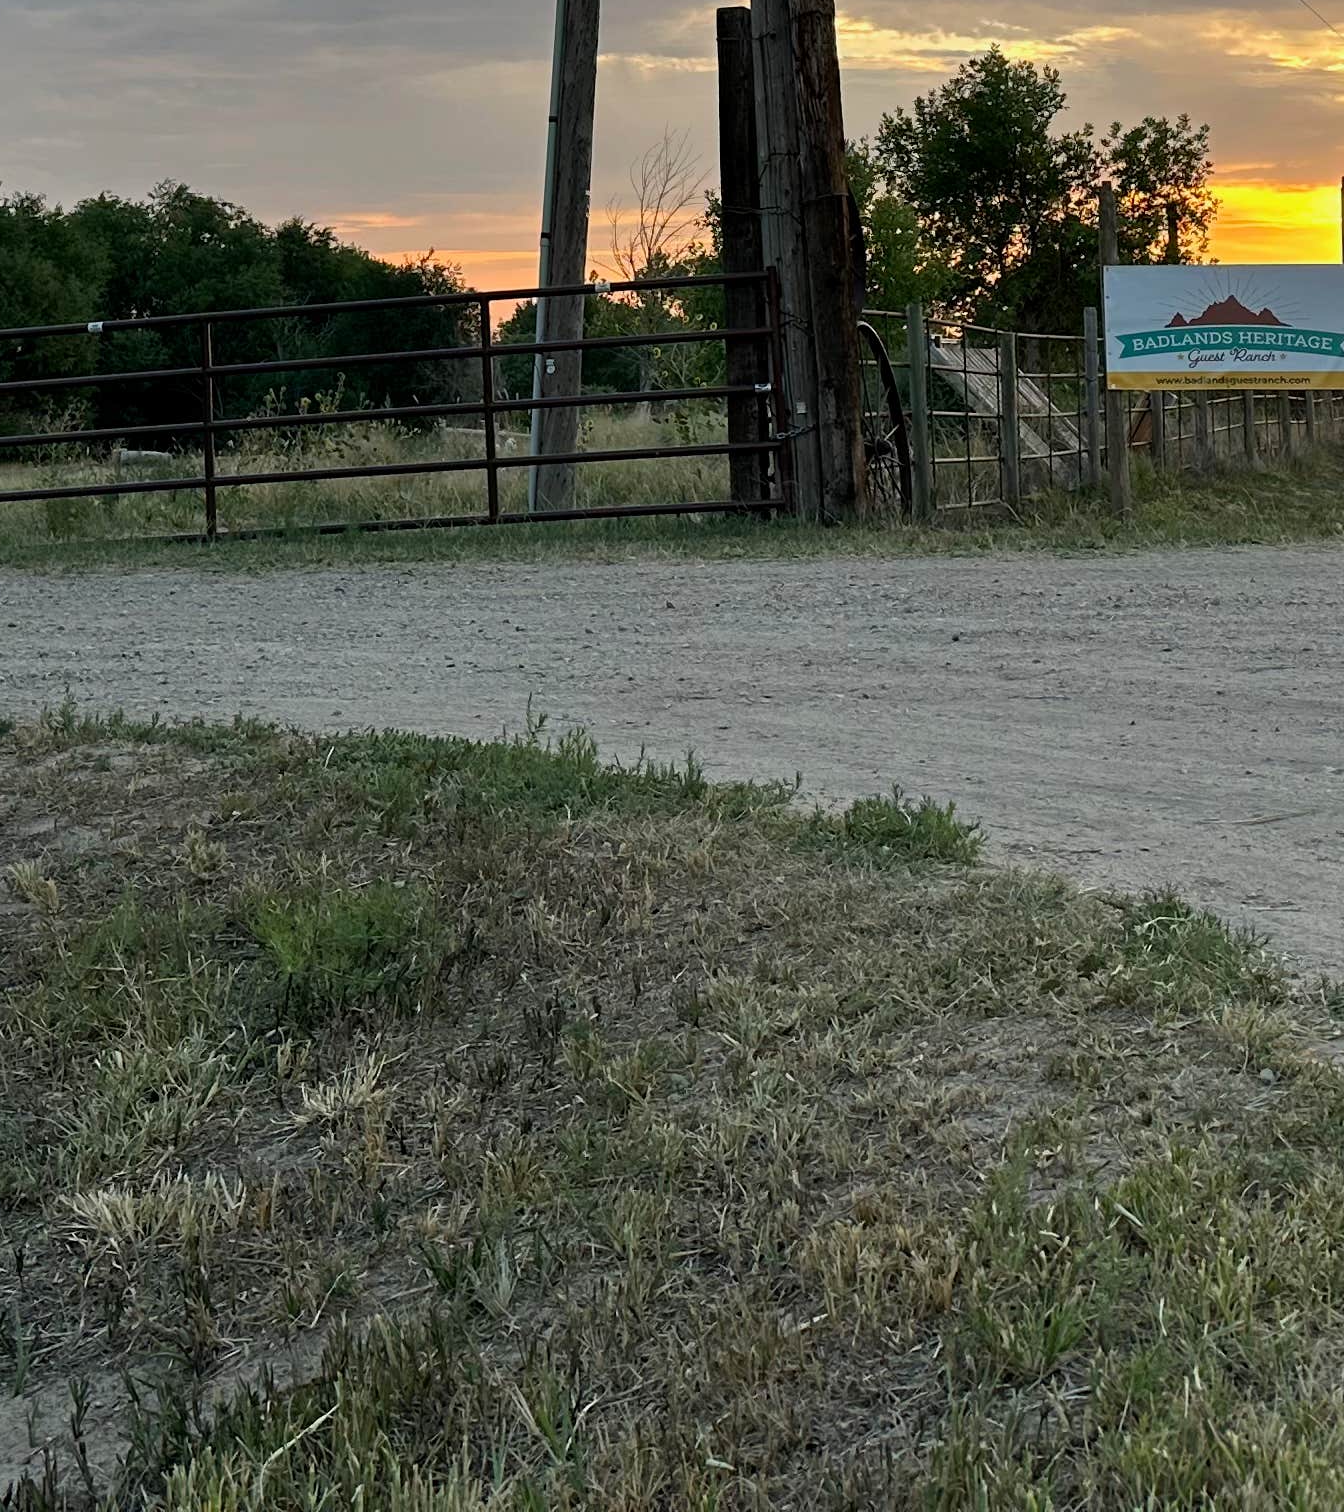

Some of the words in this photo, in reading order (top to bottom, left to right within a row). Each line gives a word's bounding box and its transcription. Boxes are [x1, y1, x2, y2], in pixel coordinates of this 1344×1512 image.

[1132, 331, 1233, 351] BADLANDS
[1239, 331, 1333, 350] HERITAGE
[1188, 348, 1225, 368] Guest
[1230, 347, 1276, 362] Ranch
